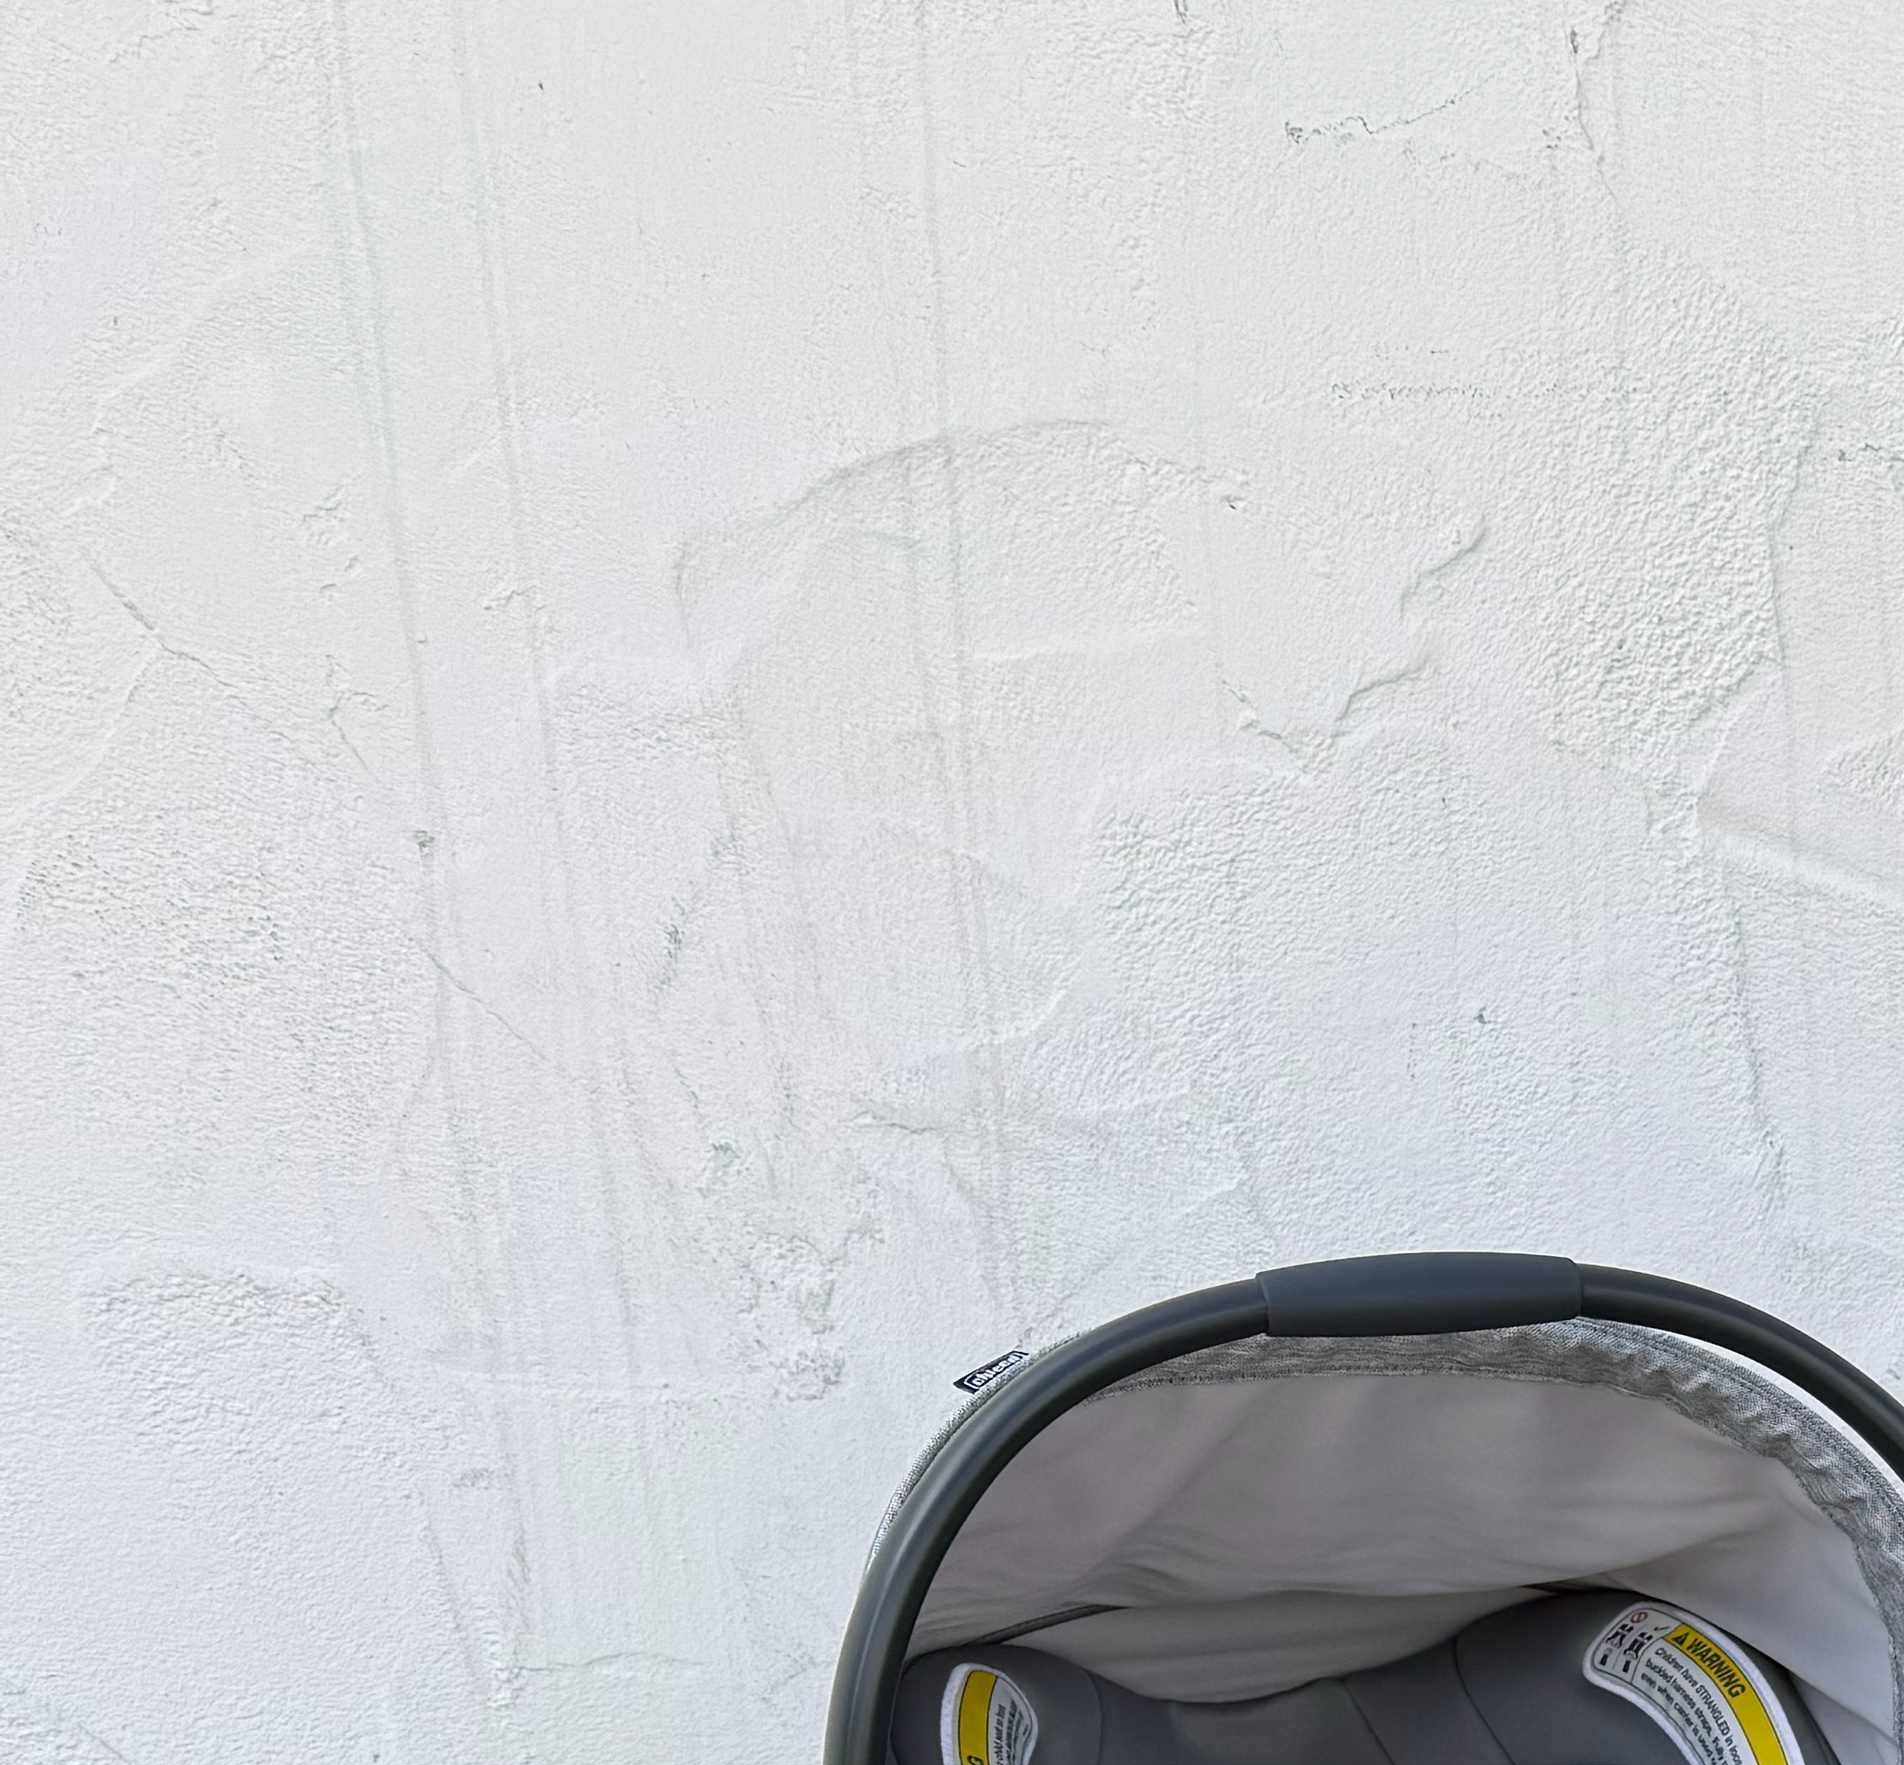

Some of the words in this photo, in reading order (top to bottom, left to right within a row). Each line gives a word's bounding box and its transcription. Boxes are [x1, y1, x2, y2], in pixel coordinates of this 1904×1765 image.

[1655, 1647, 1684, 1672] Children
[1696, 1684, 1730, 1736] STRANGLED
[1686, 1638, 1746, 1699] WARNING
